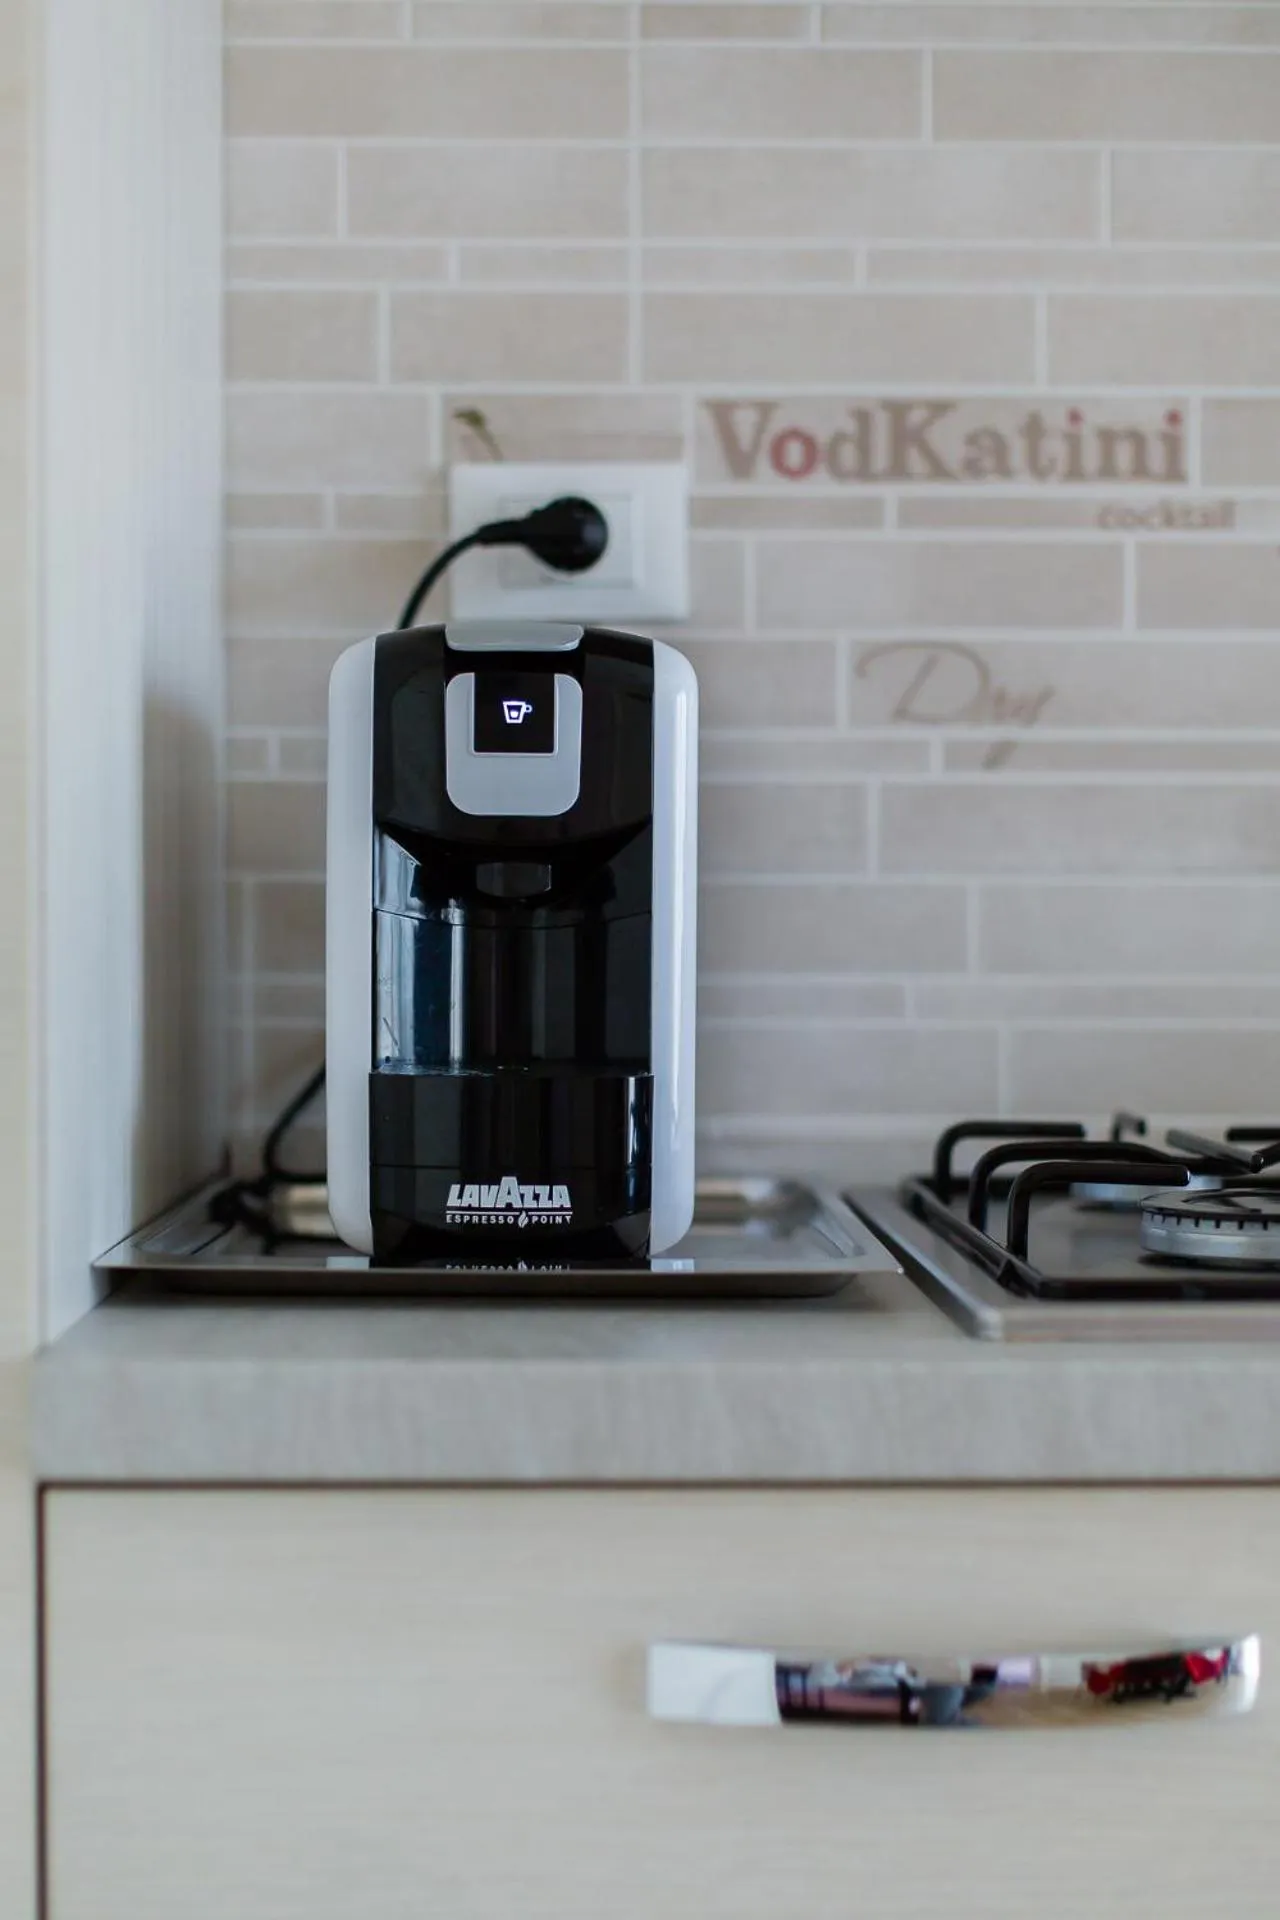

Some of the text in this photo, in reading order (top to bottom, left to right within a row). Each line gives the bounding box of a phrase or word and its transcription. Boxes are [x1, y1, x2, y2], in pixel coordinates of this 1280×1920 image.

[704, 398, 1189, 482] VodKatini
[446, 1176, 571, 1208] LAVAZZA
[446, 1214, 572, 1225] ESPRESSO POINT
